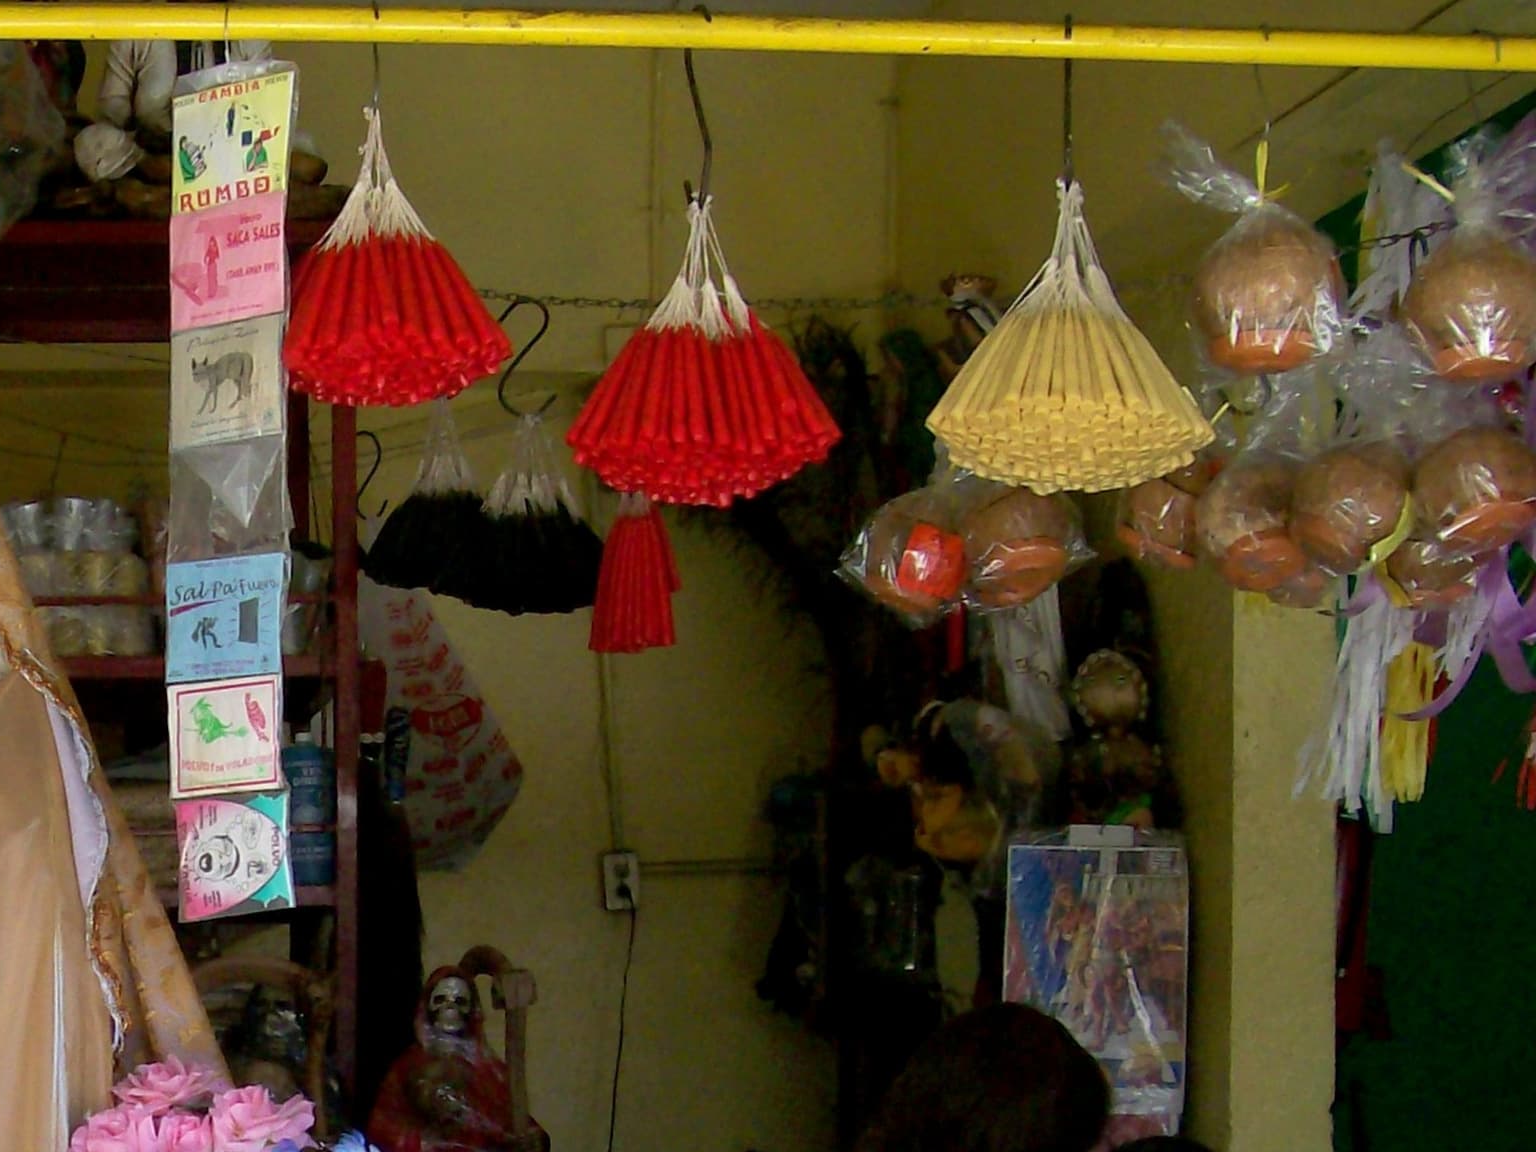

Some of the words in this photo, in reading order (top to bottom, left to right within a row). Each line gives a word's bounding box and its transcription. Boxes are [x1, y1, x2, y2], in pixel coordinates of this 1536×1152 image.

[198, 80, 261, 103] CAMBIA
[180, 176, 270, 212] RUMBO
[226, 229, 250, 247] SACA
[253, 223, 281, 242] SALES
[271, 826, 280, 868] POLVO
